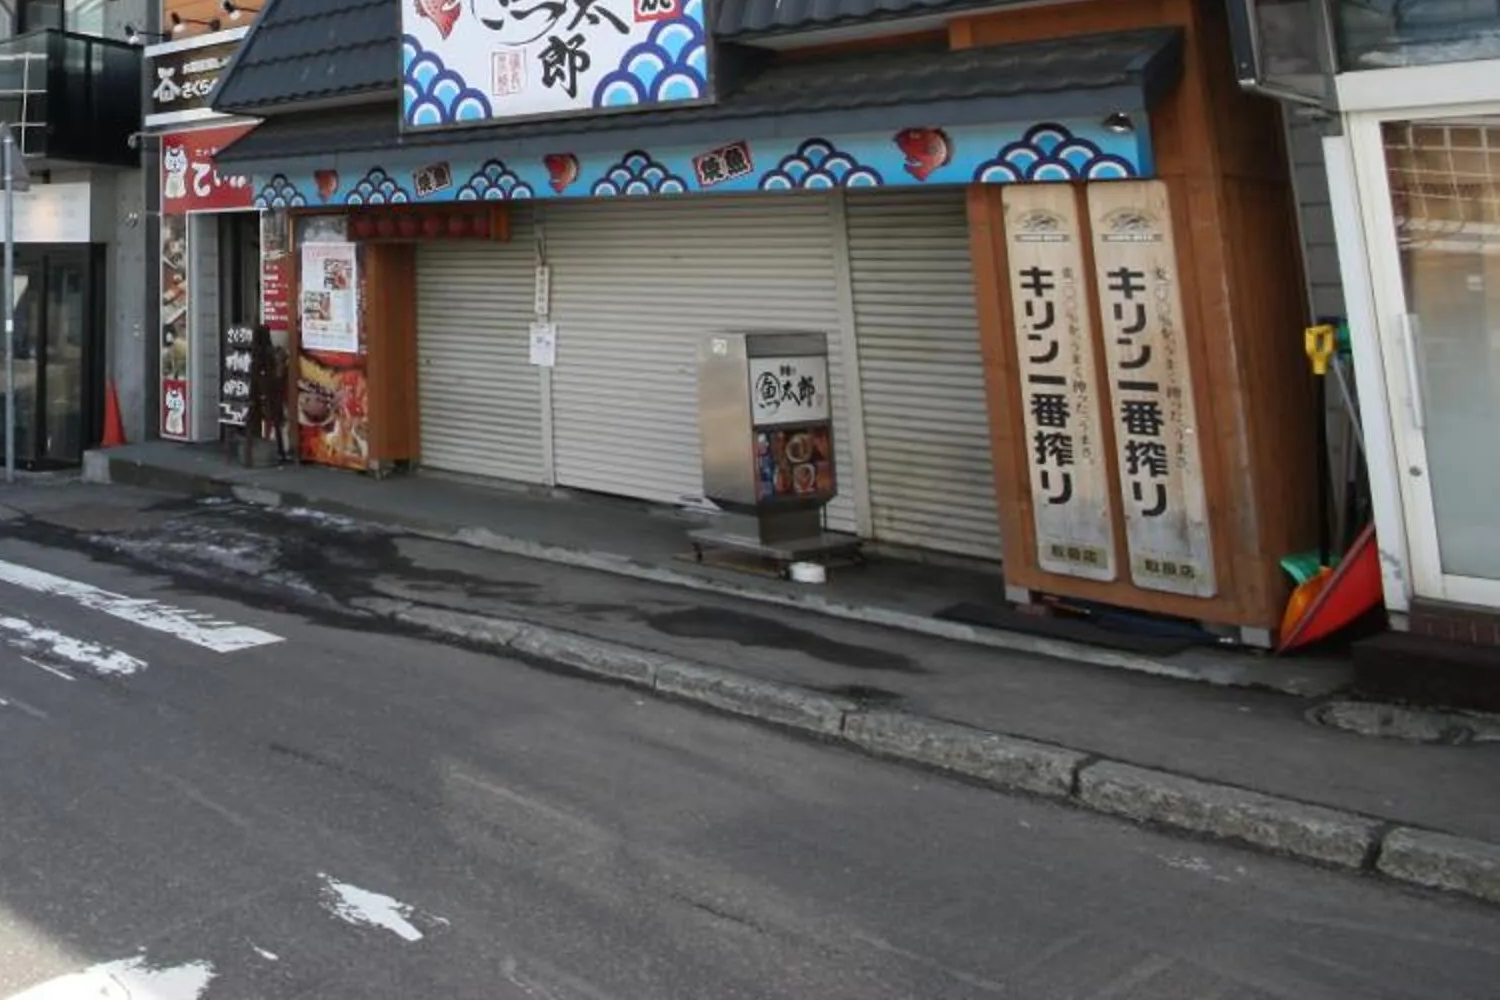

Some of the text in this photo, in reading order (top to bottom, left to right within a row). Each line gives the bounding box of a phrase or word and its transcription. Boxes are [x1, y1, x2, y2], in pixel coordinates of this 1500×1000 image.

[1019, 266, 1074, 505] キリン一番搾り
[1107, 266, 1170, 518] キリン一番搾り
